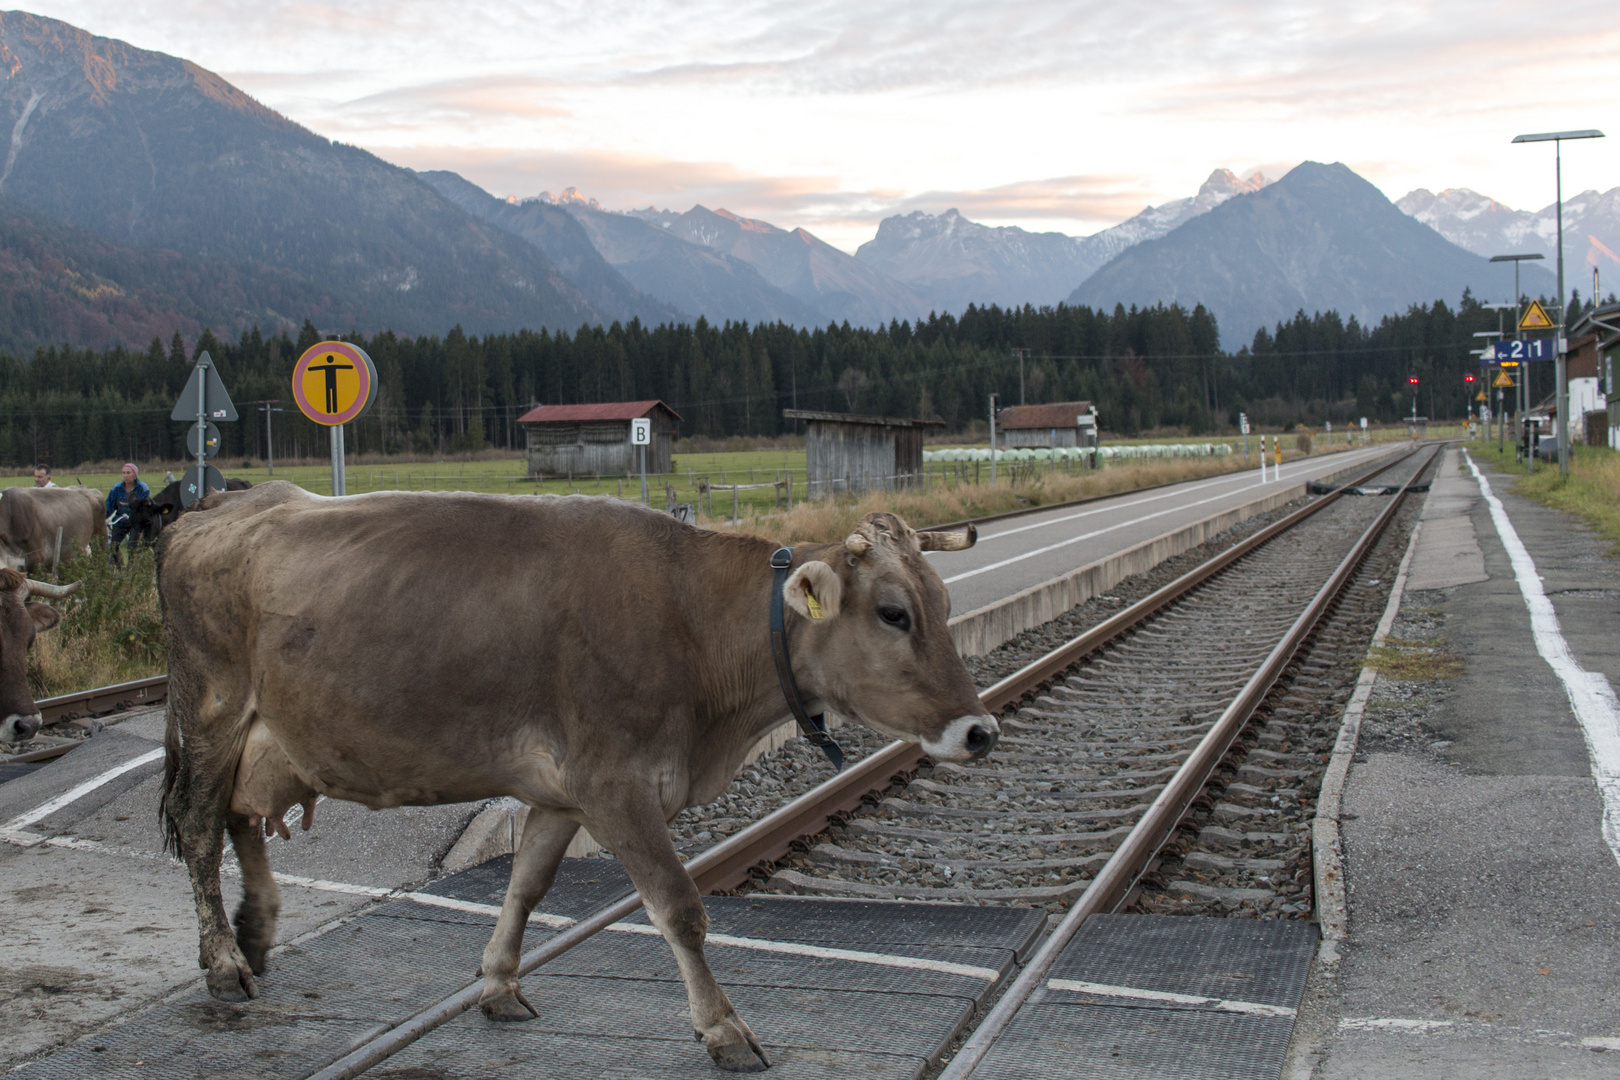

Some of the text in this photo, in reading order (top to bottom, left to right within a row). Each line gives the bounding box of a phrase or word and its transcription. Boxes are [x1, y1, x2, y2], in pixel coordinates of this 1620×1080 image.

[1511, 339, 1542, 359] 2 1
[636, 426, 646, 442] B
